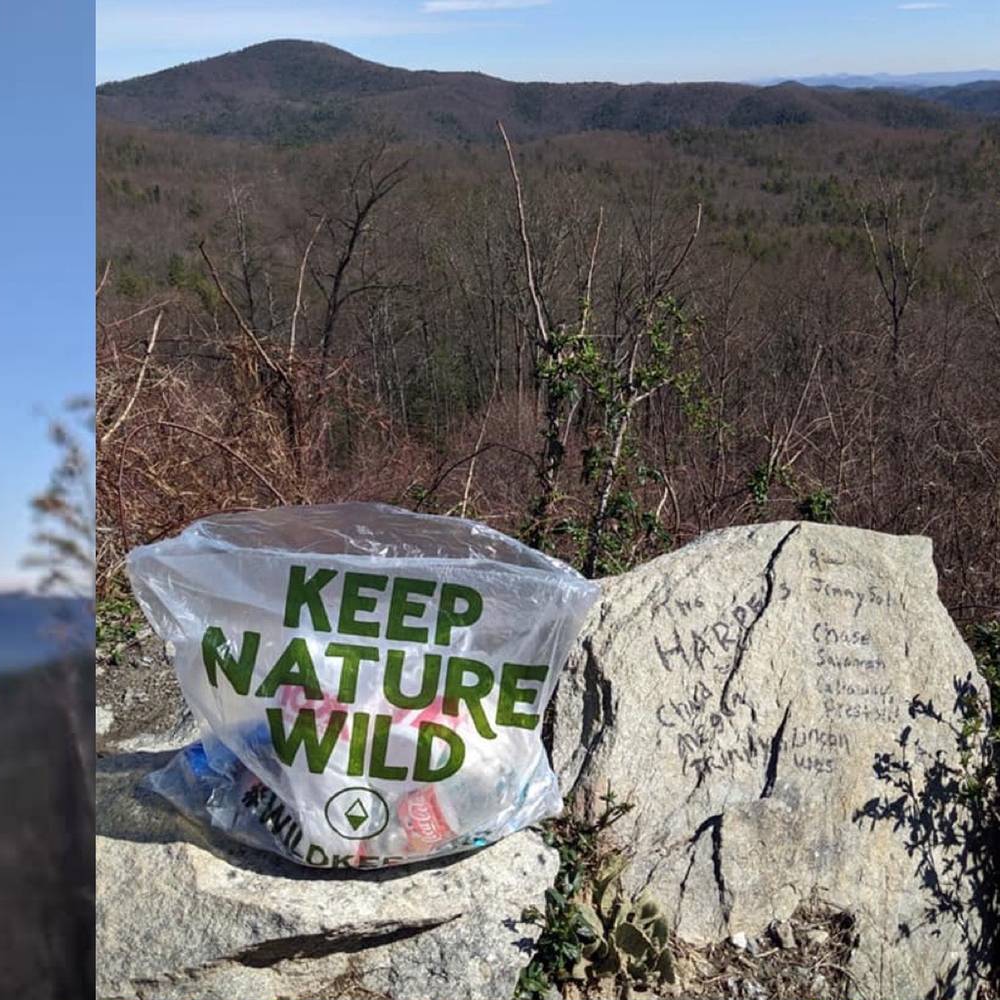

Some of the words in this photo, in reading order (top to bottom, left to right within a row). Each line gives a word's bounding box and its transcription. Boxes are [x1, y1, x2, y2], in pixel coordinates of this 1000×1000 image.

[283, 565, 483, 646] KEEP
[201, 626, 549, 740] NATURE
[266, 708, 466, 783] WILD
